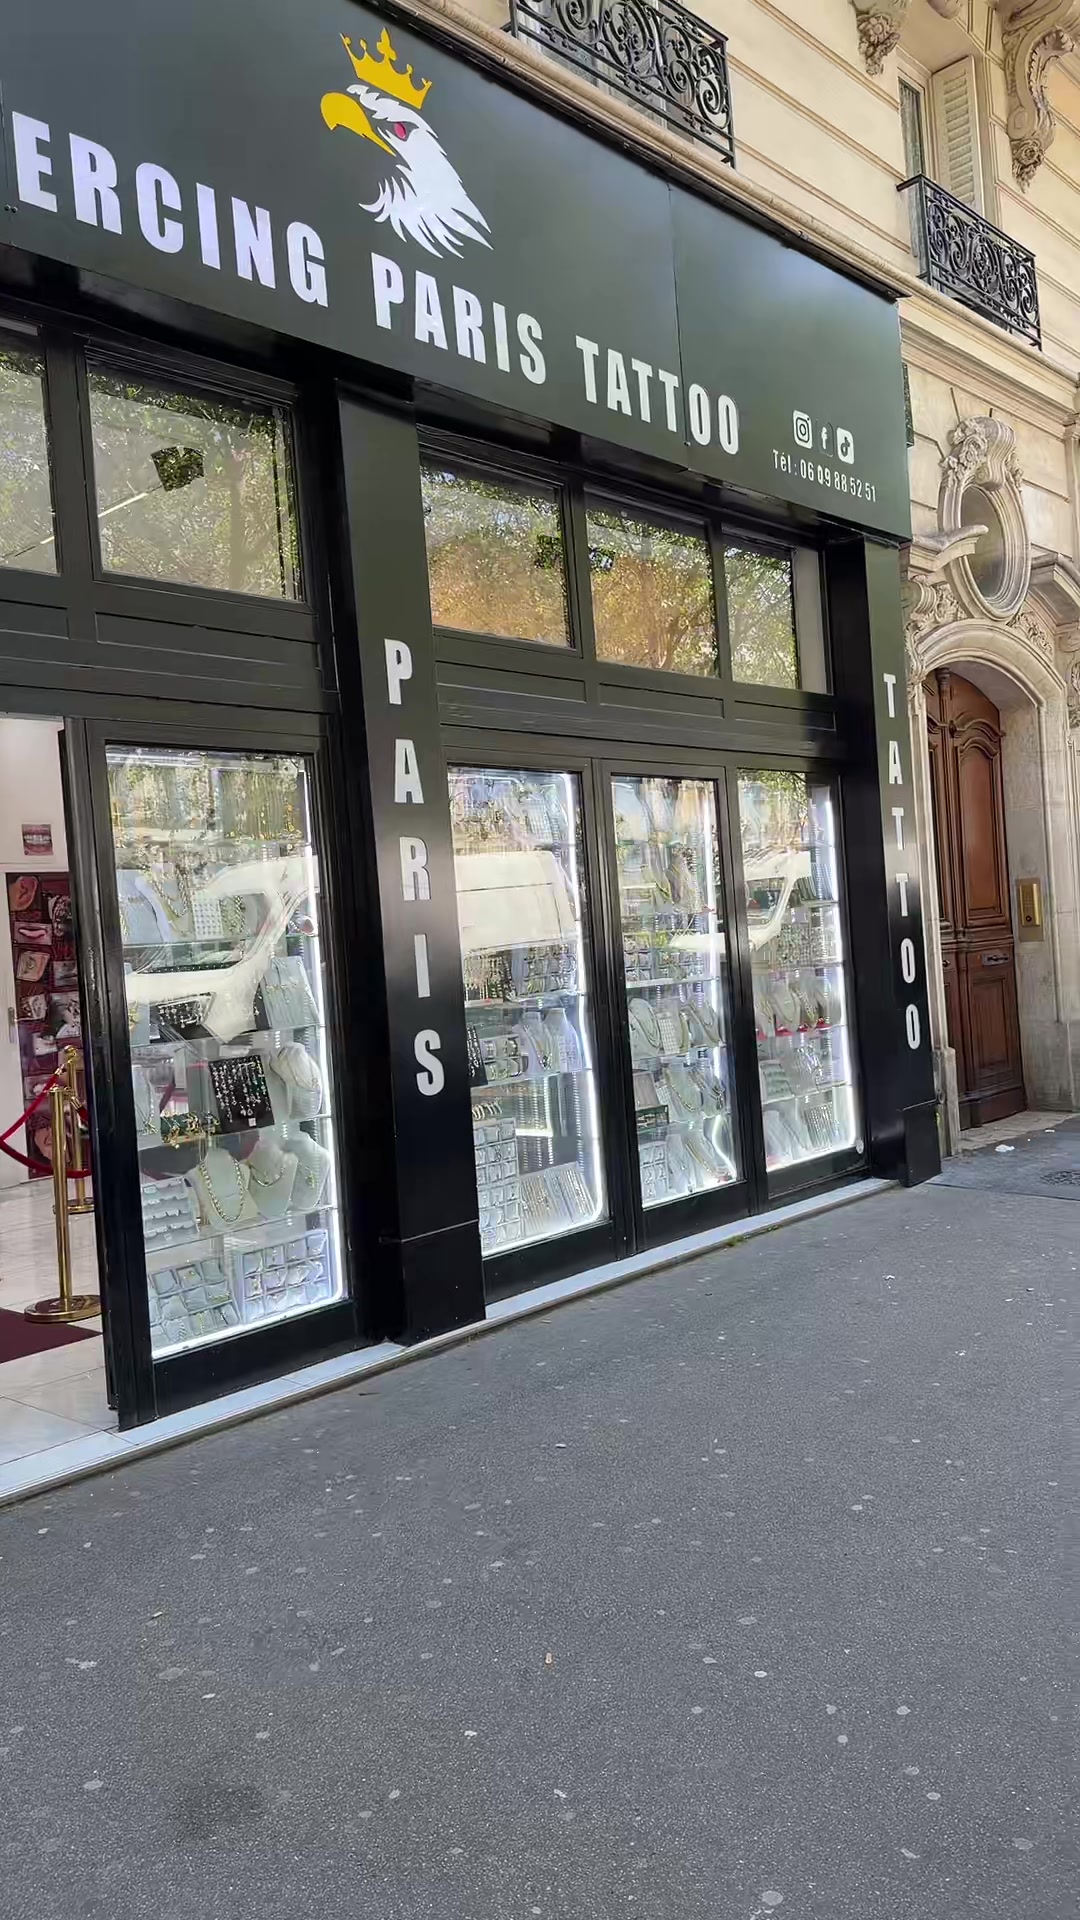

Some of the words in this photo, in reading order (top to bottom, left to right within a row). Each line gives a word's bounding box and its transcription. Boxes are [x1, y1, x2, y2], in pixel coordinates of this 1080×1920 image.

[12, 112, 328, 307] ERCING
[371, 252, 547, 385] PARIS
[575, 335, 739, 455] TATTOO
[800, 458, 815, 482] 06
[817, 464, 831, 488] 09
[834, 471, 848, 493] 88
[850, 476, 863, 498] 52
[865, 482, 876, 503] 51
[384, 638, 445, 1097] PARIS
[882, 674, 922, 1050] TATTOO
